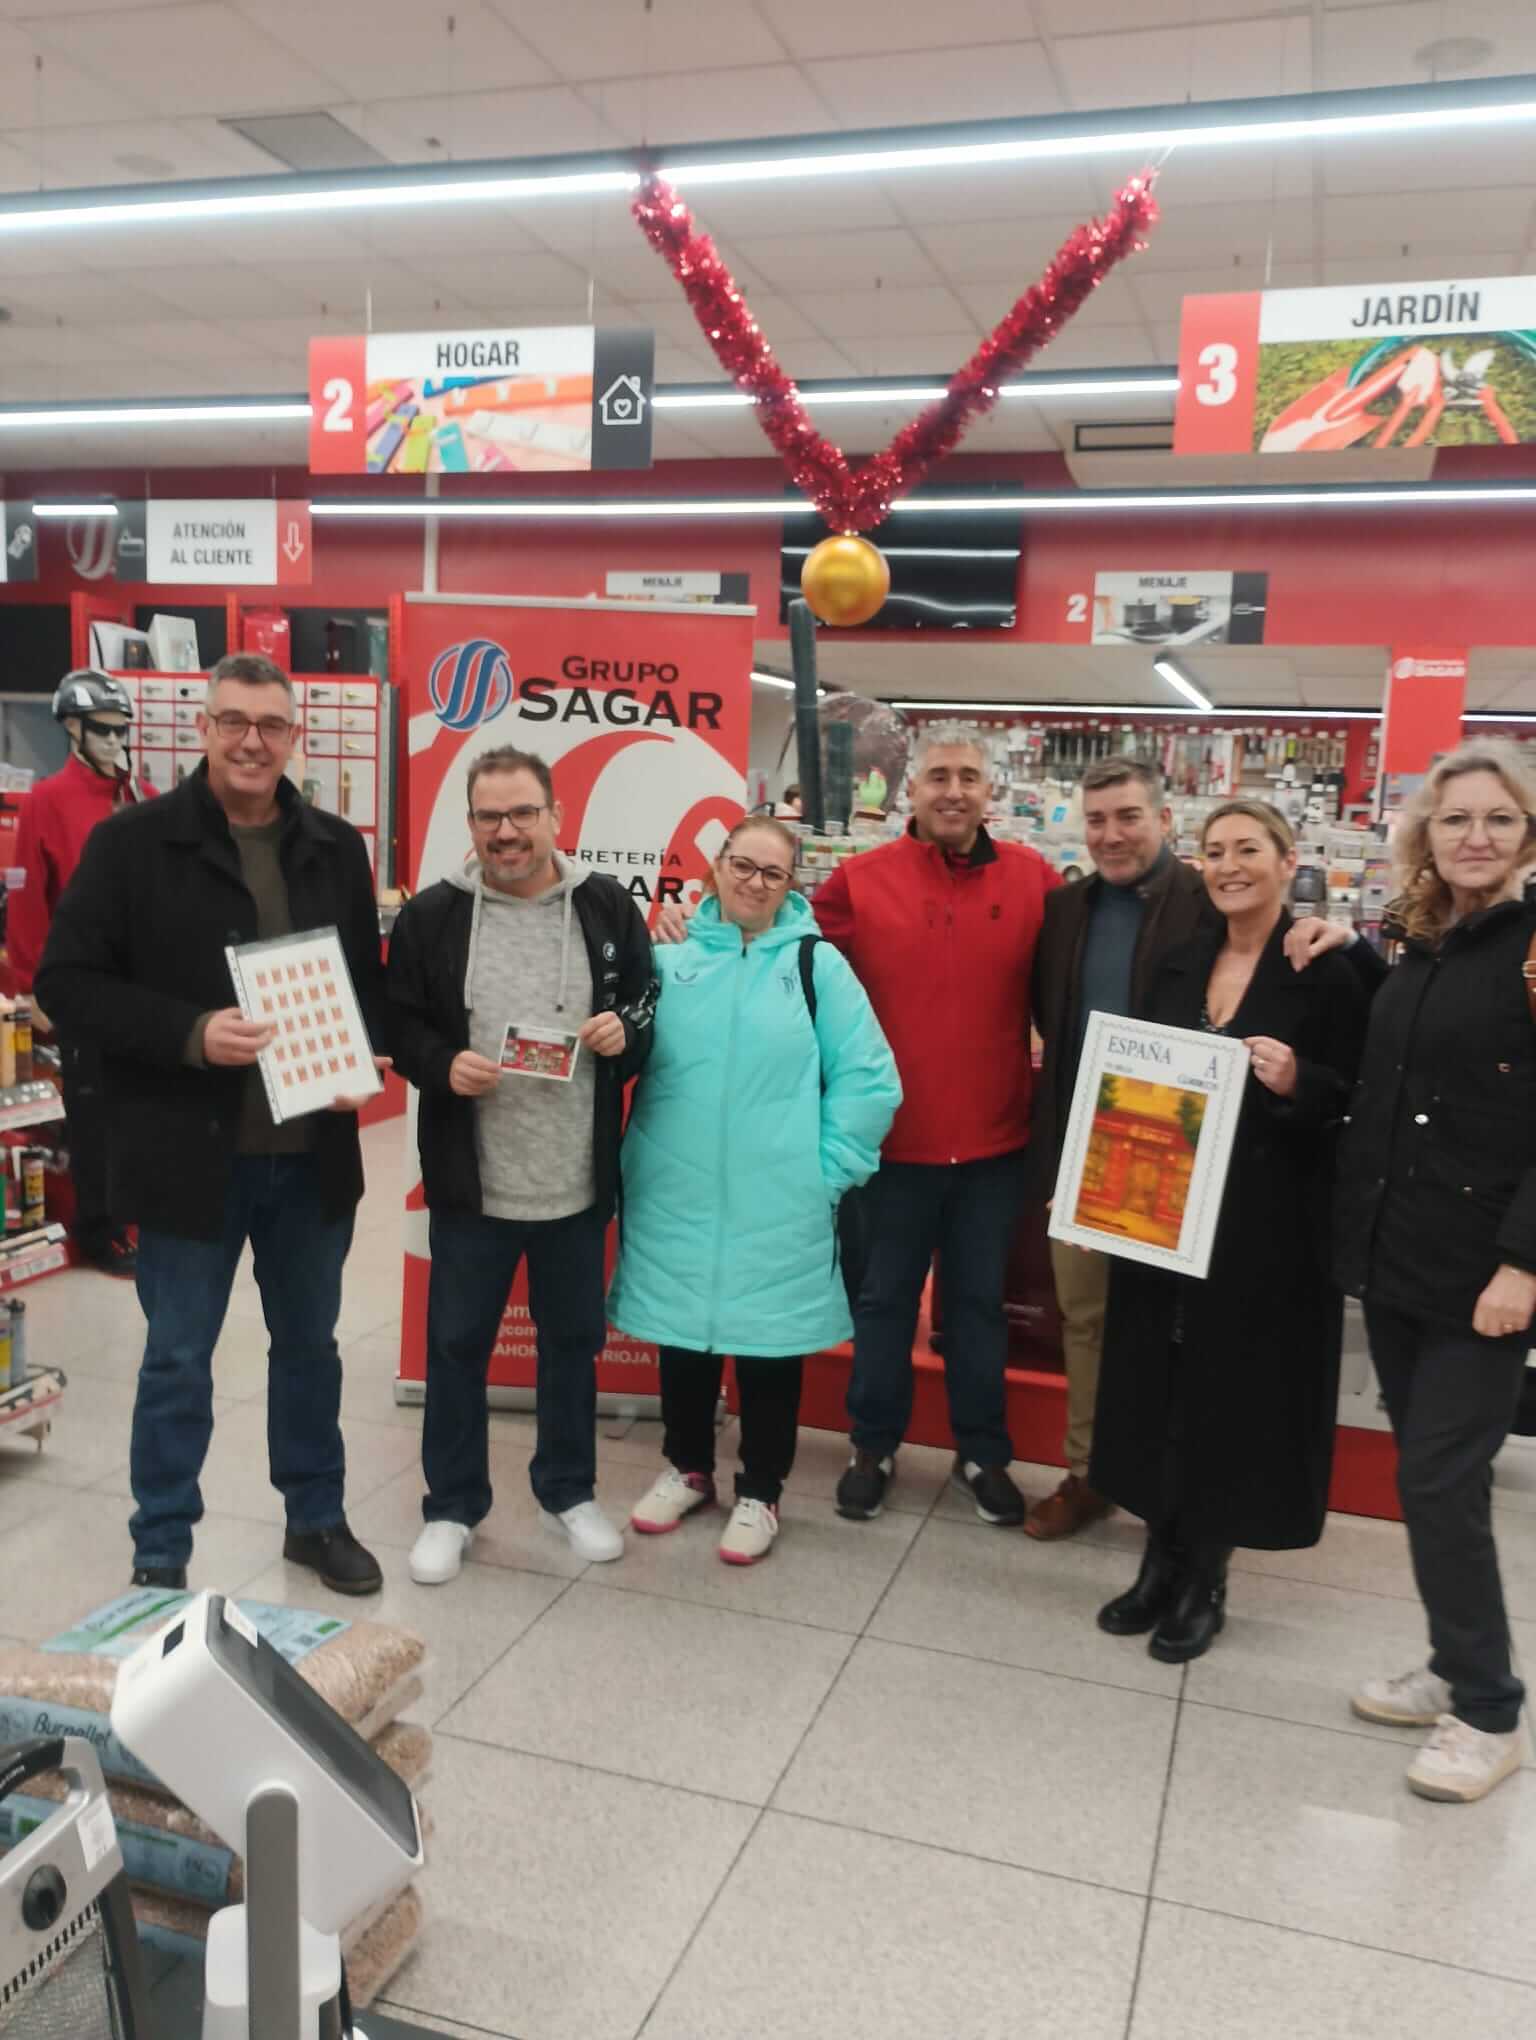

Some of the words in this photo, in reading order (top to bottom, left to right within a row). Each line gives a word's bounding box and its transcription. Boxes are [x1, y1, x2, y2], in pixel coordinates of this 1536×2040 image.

[1352, 284, 1480, 327] JARDÍN
[436, 341, 520, 368] HOGAR
[1195, 343, 1238, 406] 3
[322, 378, 354, 432] 2
[173, 519, 246, 538] ATENCIÓN
[170, 549, 188, 564] AL
[193, 549, 254, 565] CLIENTE
[1137, 577, 1188, 588] MENAJE
[1066, 594, 1088, 622] 2
[518, 677, 724, 730] SAGAR
[627, 875, 685, 904] AR
[1107, 1035, 1171, 1065] ESPAÑA
[1203, 1055, 1218, 1079] A
[602, 1349, 651, 1365] RIOJA
